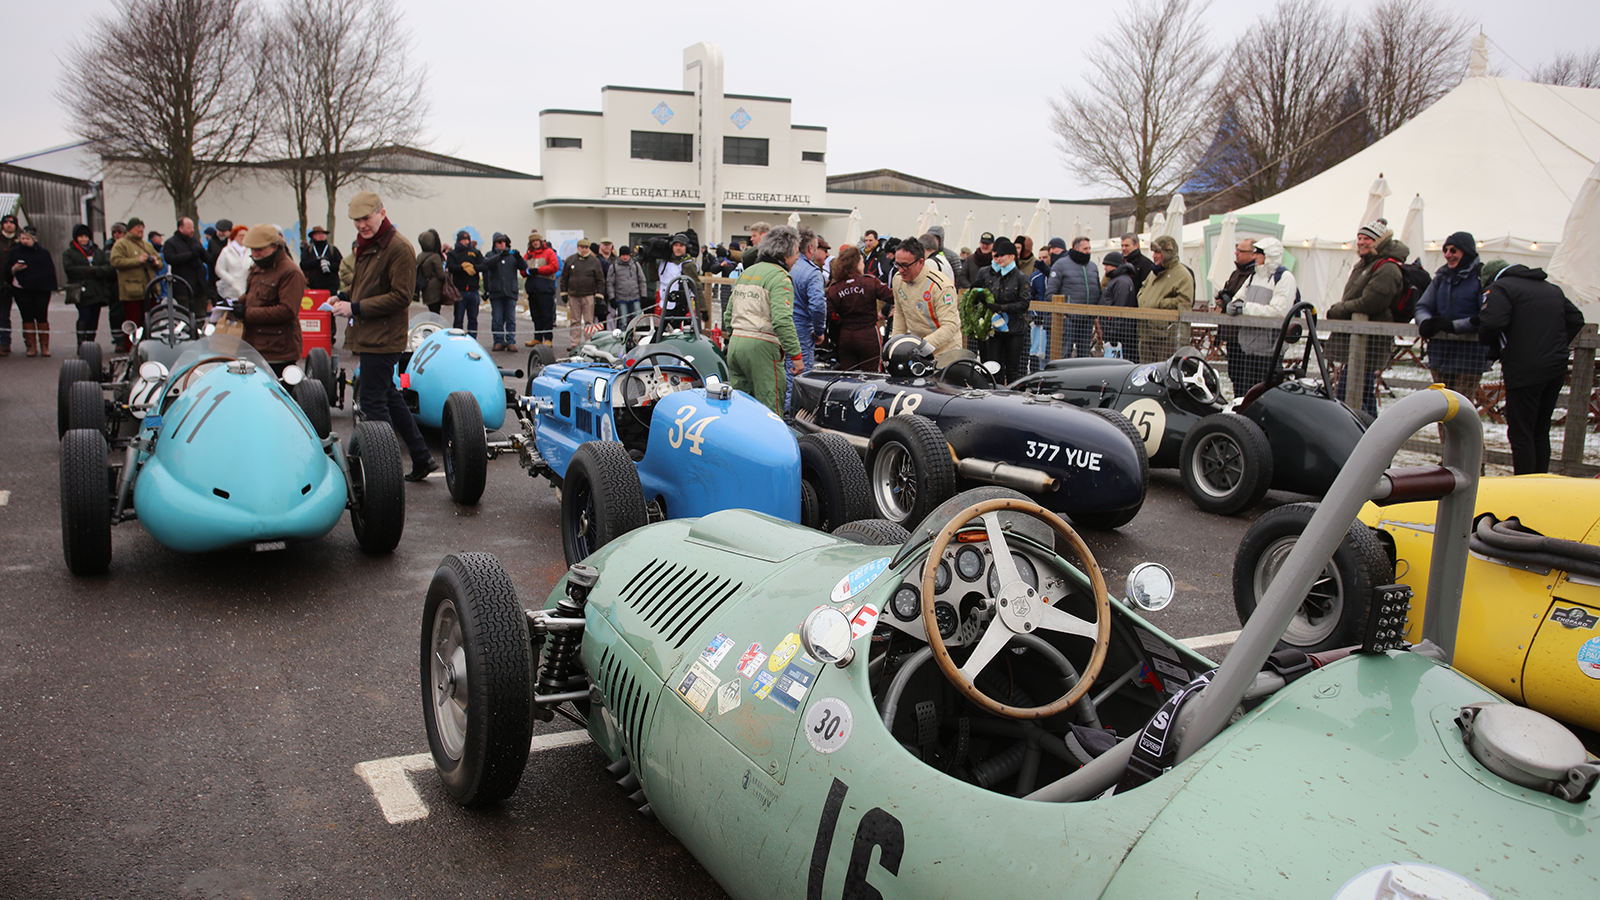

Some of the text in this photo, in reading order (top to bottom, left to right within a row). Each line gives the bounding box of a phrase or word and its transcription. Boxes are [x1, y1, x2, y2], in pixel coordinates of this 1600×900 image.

[605, 187, 701, 199] THE GREAT HALL
[724, 191, 810, 204] THE GREAT HALL
[631, 221, 668, 230] ENTRANCE
[747, 290, 760, 300] Club
[413, 340, 442, 375] 42
[171, 384, 232, 444] 11
[888, 389, 923, 418] 18
[668, 405, 720, 456] 34
[1129, 409, 1155, 442] 15
[1026, 440, 1103, 472] 377 YUE
[851, 573, 878, 594] 2013
[1585, 652, 1600, 660] PAU
[814, 708, 841, 741] 30
